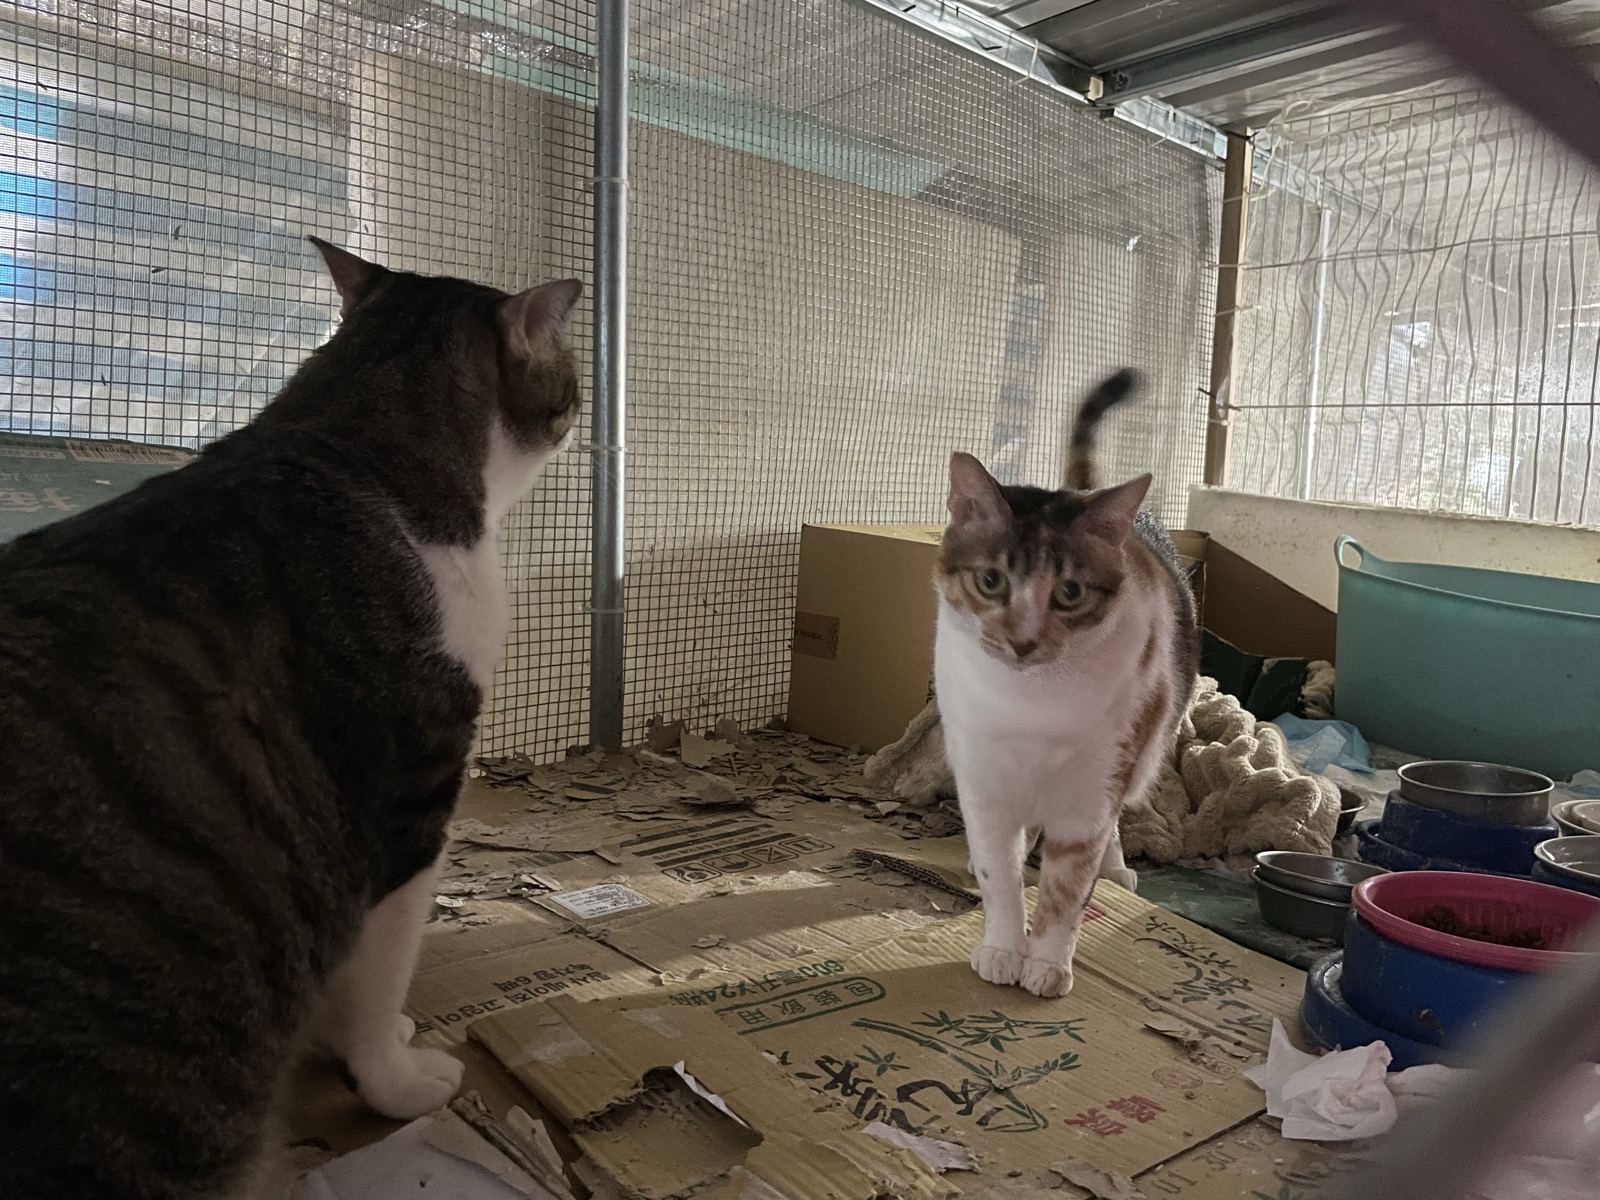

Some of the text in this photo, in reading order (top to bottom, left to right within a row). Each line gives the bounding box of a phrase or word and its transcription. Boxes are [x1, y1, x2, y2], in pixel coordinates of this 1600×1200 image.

[492, 963, 594, 993] 녹차향 6팩
[571, 971, 612, 987] 탐사
[505, 981, 570, 1005] 베이직
[434, 999, 505, 1026] 고양이
[1064, 1094, 1167, 1137] 峰泉
